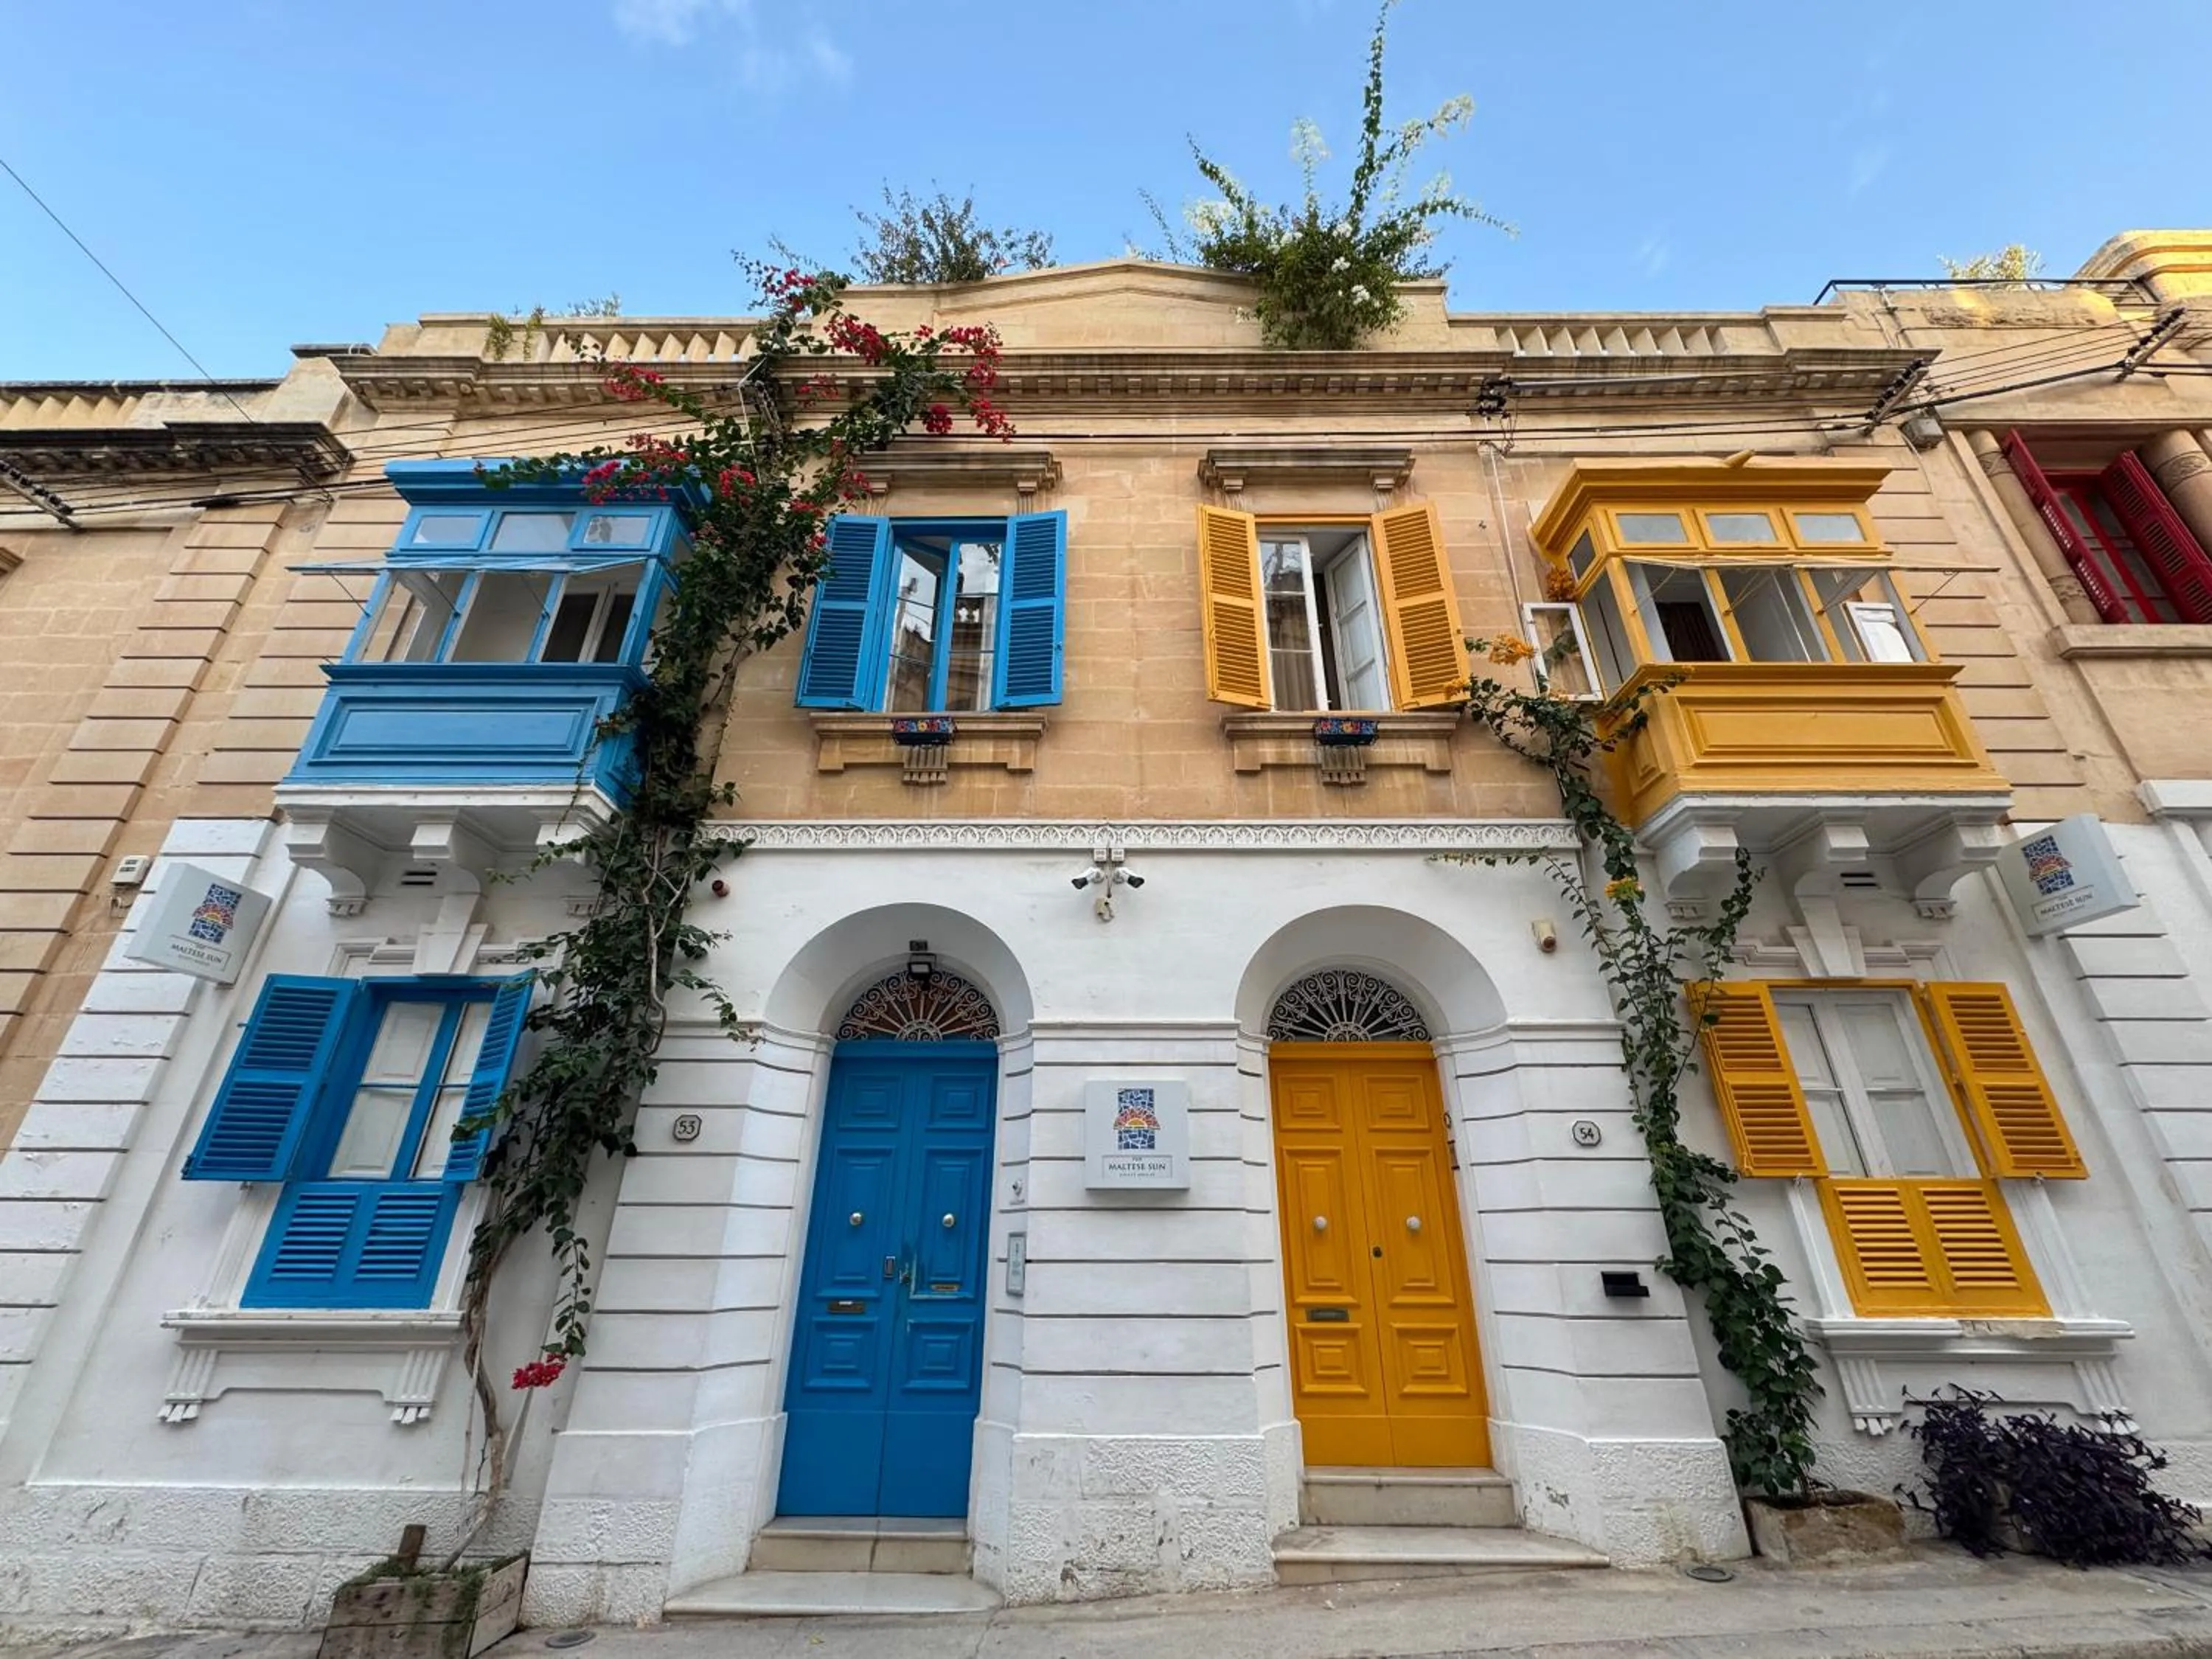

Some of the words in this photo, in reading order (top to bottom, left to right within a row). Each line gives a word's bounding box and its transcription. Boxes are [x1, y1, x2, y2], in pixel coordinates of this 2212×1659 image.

[678, 1120, 695, 1135] 53
[1579, 1127, 1595, 1140] 54
[1108, 1163, 1146, 1171] MALTESE
[1148, 1163, 1166, 1171] SUN
